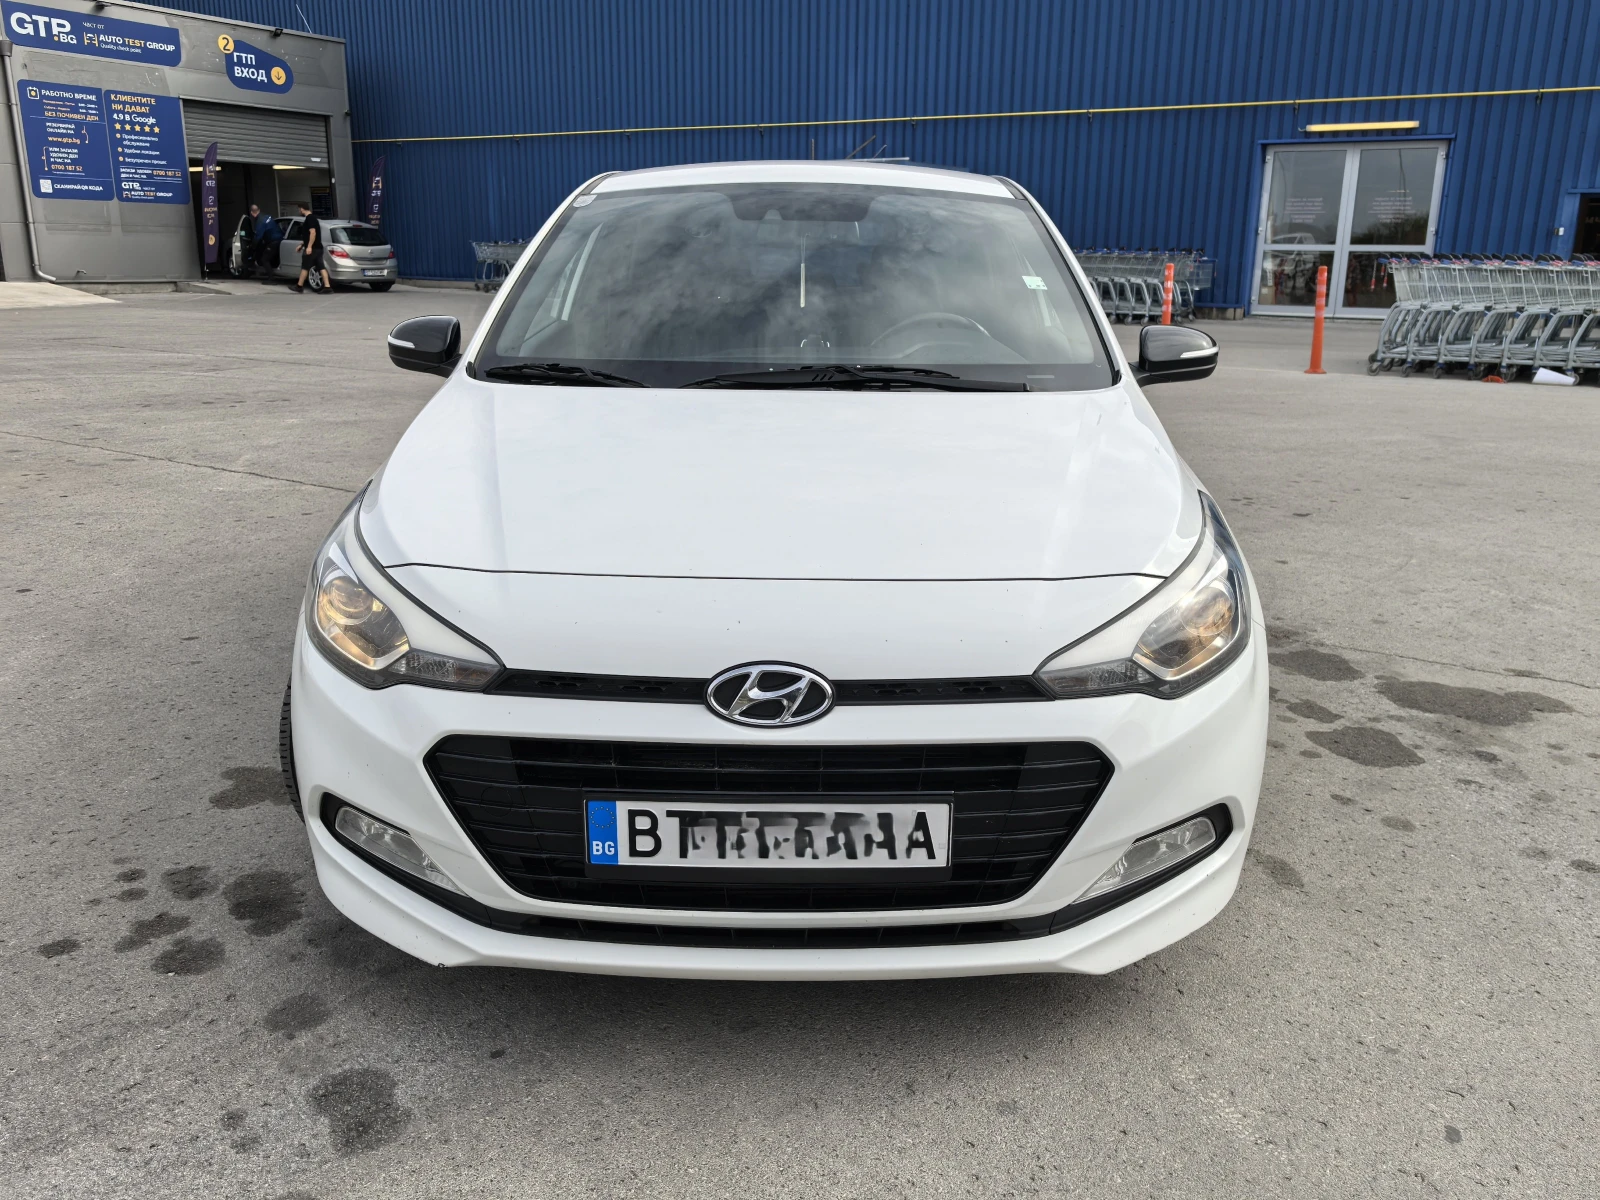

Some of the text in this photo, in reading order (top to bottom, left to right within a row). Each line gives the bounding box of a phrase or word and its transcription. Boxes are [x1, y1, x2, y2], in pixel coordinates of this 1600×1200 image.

[10, 12, 71, 37] GTP
[100, 34, 176, 52] AUTO TEST GROUP
[100, 42, 116, 50] Quality
[222, 36, 230, 52] 2
[233, 52, 256, 66] ГТП
[234, 66, 268, 83] ВХОД
[41, 90, 74, 99] РАБОТНО
[110, 94, 156, 105] КЛИЕНТИТЕ
[125, 105, 150, 113] ДАВАТ
[132, 114, 156, 124] Google
[48, 136, 80, 144] www.gtp.bg
[592, 840, 615, 856] BG
